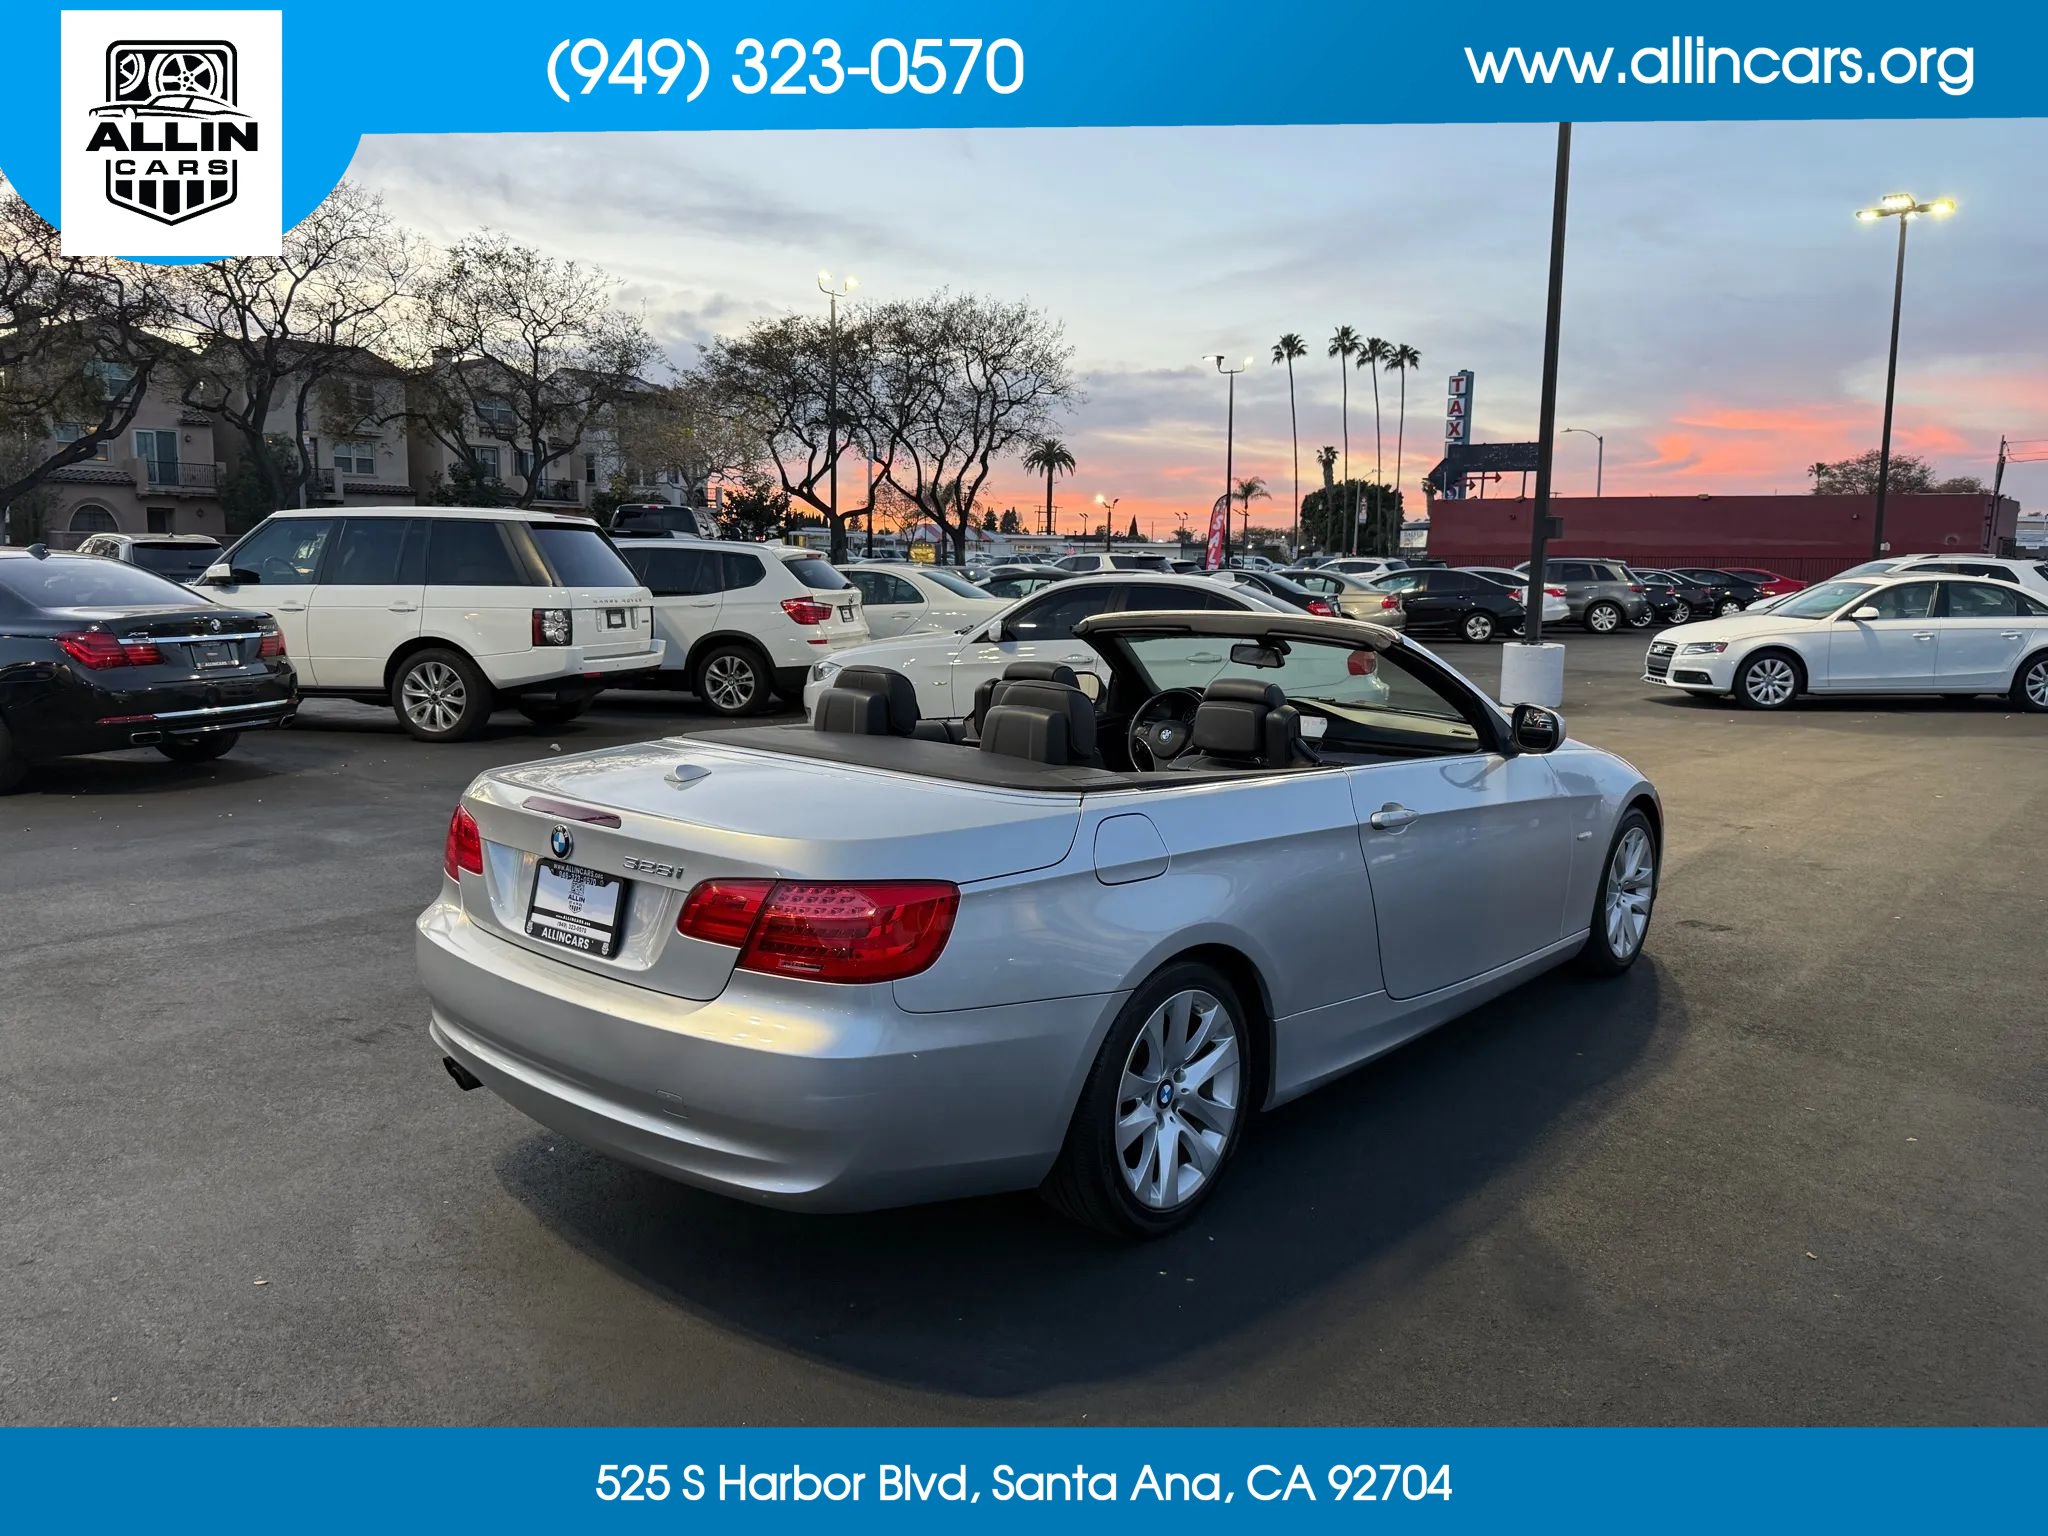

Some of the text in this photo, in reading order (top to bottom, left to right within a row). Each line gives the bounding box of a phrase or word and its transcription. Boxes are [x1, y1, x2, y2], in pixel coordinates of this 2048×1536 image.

[1448, 377, 1465, 436] TAX
[623, 855, 684, 880] 328i
[541, 927, 590, 950] ALLINCARS
